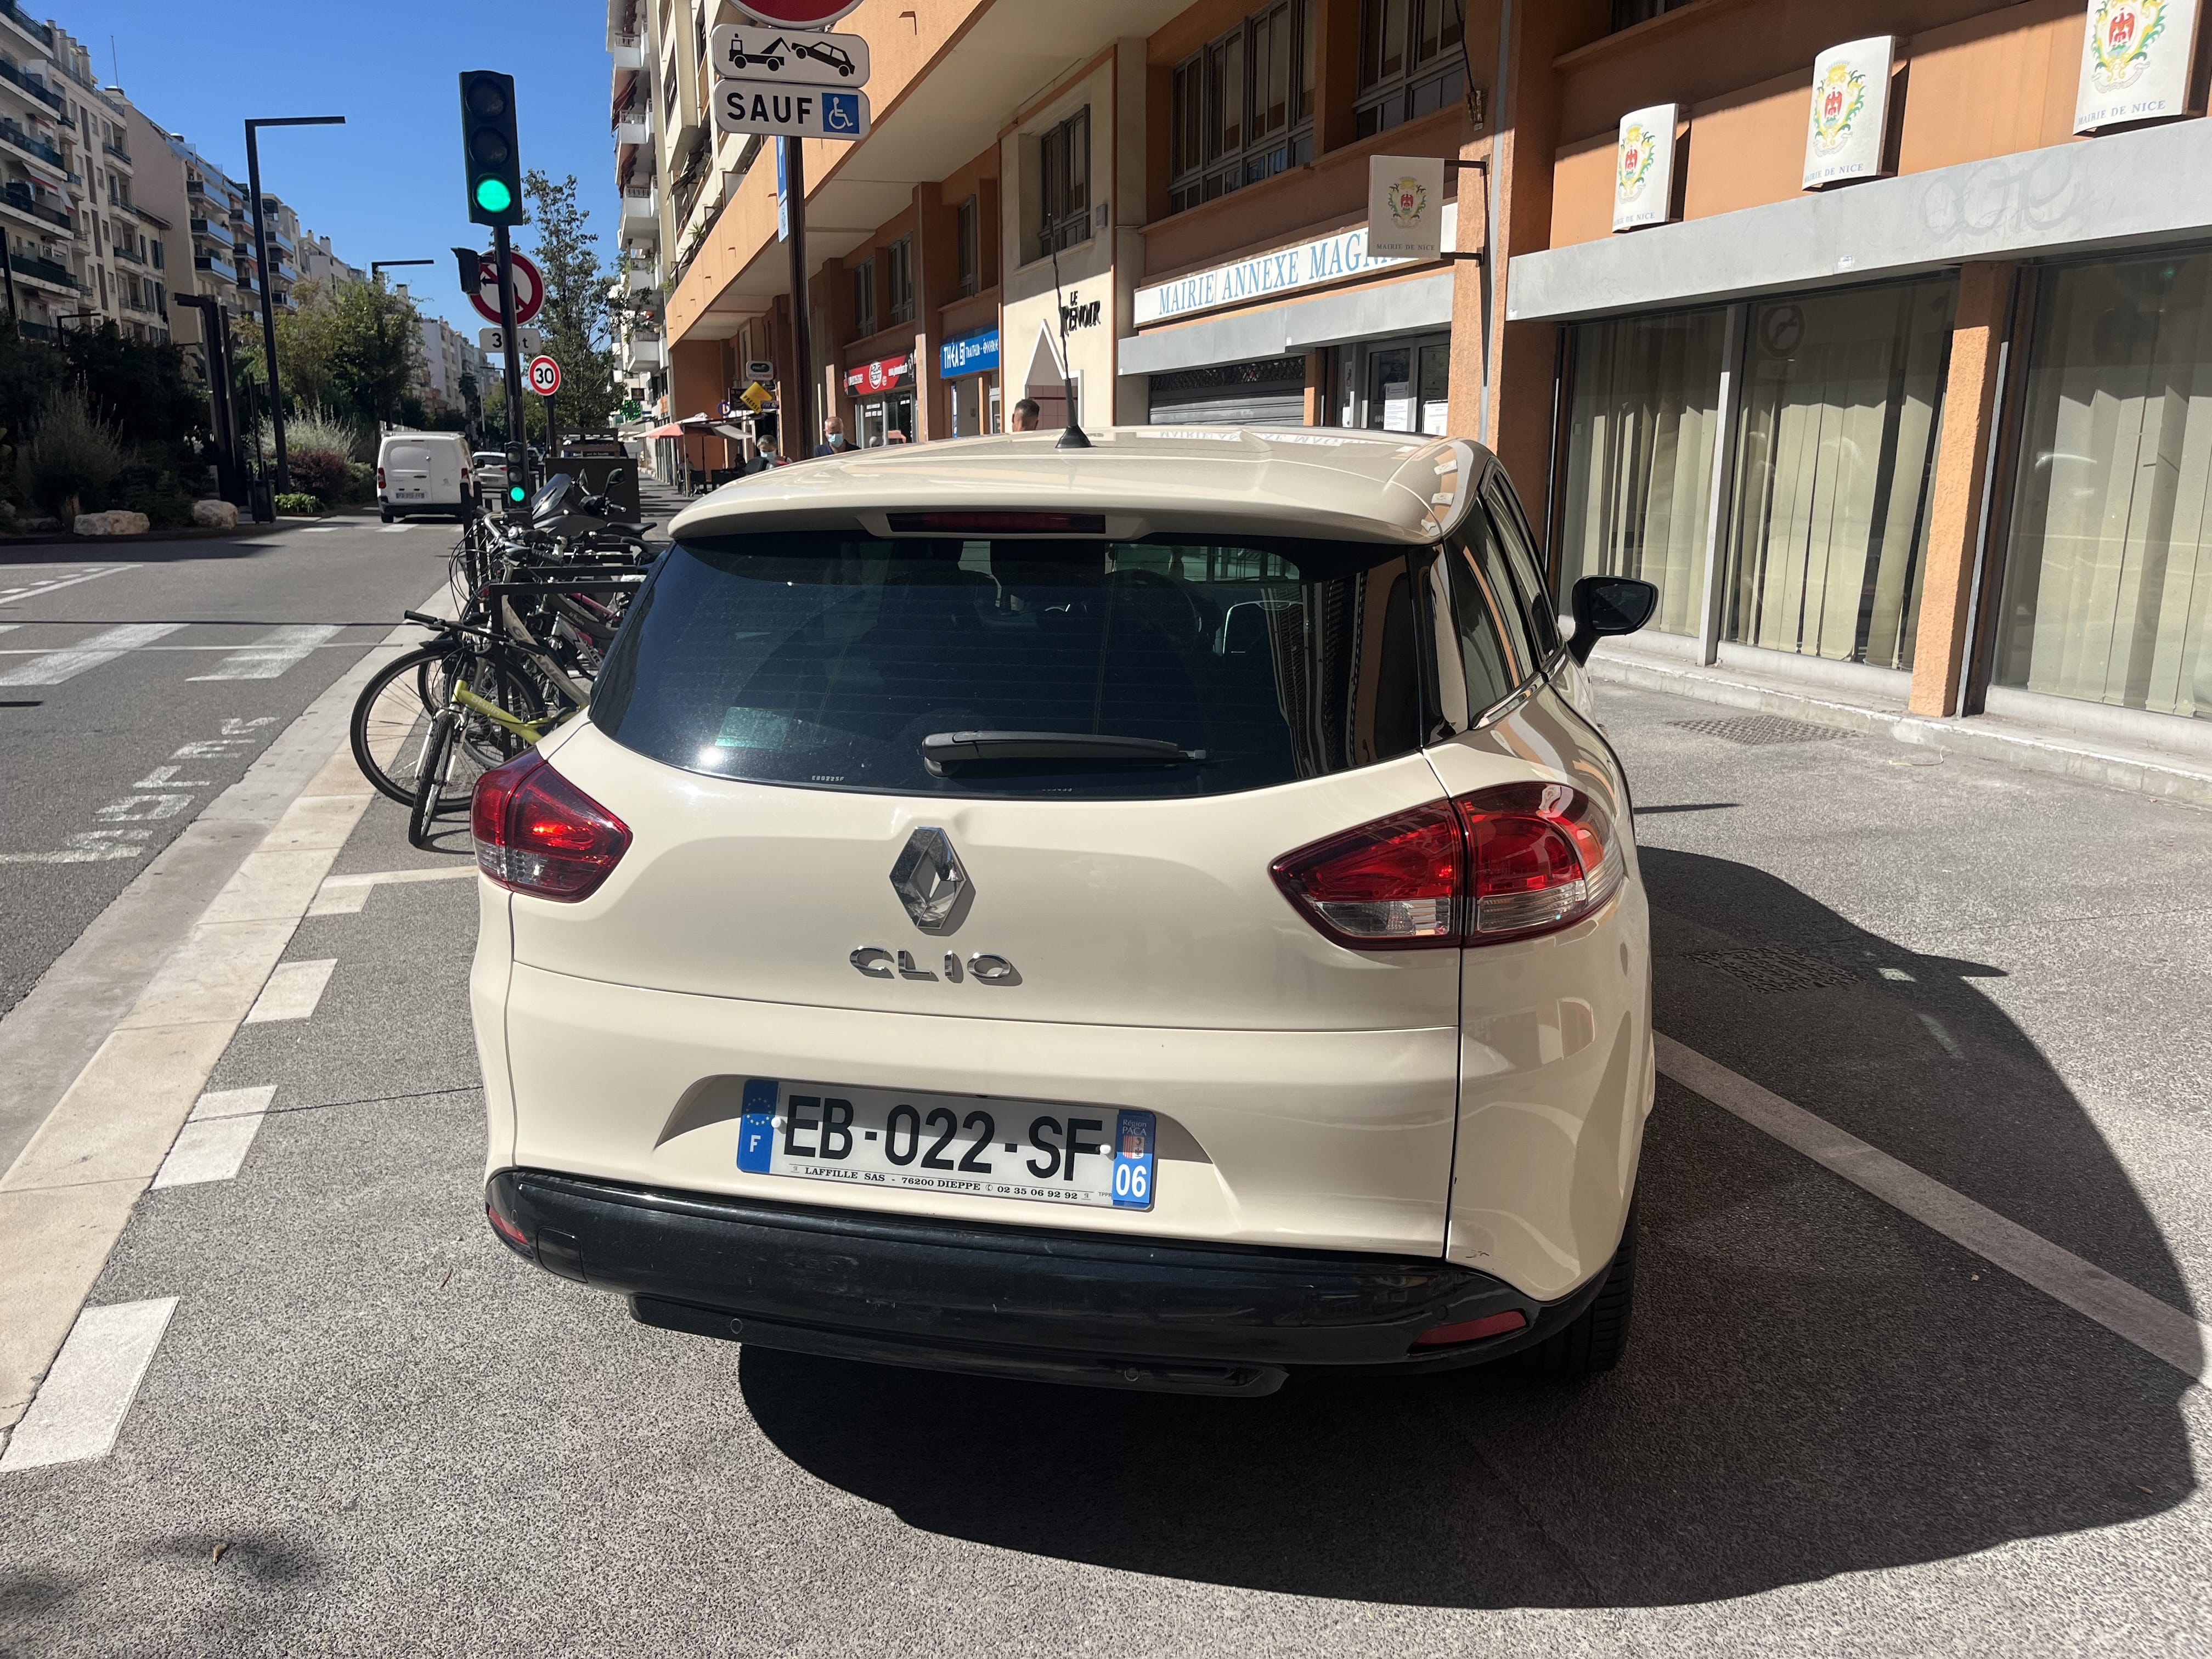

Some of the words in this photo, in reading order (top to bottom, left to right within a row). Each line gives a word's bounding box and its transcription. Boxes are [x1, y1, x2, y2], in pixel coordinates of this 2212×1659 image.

[727, 92, 812, 125] SAUF
[2078, 109, 2107, 126] MAIRIE
[2111, 105, 2126, 117] DE
[2131, 100, 2166, 113] NICE
[1825, 167, 1835, 177] DE
[1838, 163, 1864, 174] NICE
[1637, 212, 1655, 221] NICE
[1159, 274, 1214, 315] MAIRIE
[1221, 250, 1299, 301] ANNEXE
[1309, 232, 1399, 280] MAG
[1070, 290, 1079, 307] LE
[943, 339, 960, 369] THÉA
[535, 368, 554, 384] 30
[743, 394, 760, 411] PRESSE
[849, 945, 1011, 980] CLIO
[1122, 1119, 1147, 1128] Région
[1122, 1126, 1147, 1136] PACA
[749, 1135, 761, 1153] F
[783, 1094, 1103, 1181] EB-022-SF
[805, 1167, 858, 1179] LAFFILLE
[864, 1173, 885, 1182] SAS
[901, 1177, 934, 1187] 76200
[937, 1180, 981, 1190] DIEPPE
[1030, 1188, 1044, 1197] 06
[1047, 1190, 1061, 1198] 92
[1064, 1192, 1078, 1200] 92
[1115, 1164, 1147, 1198] 06
